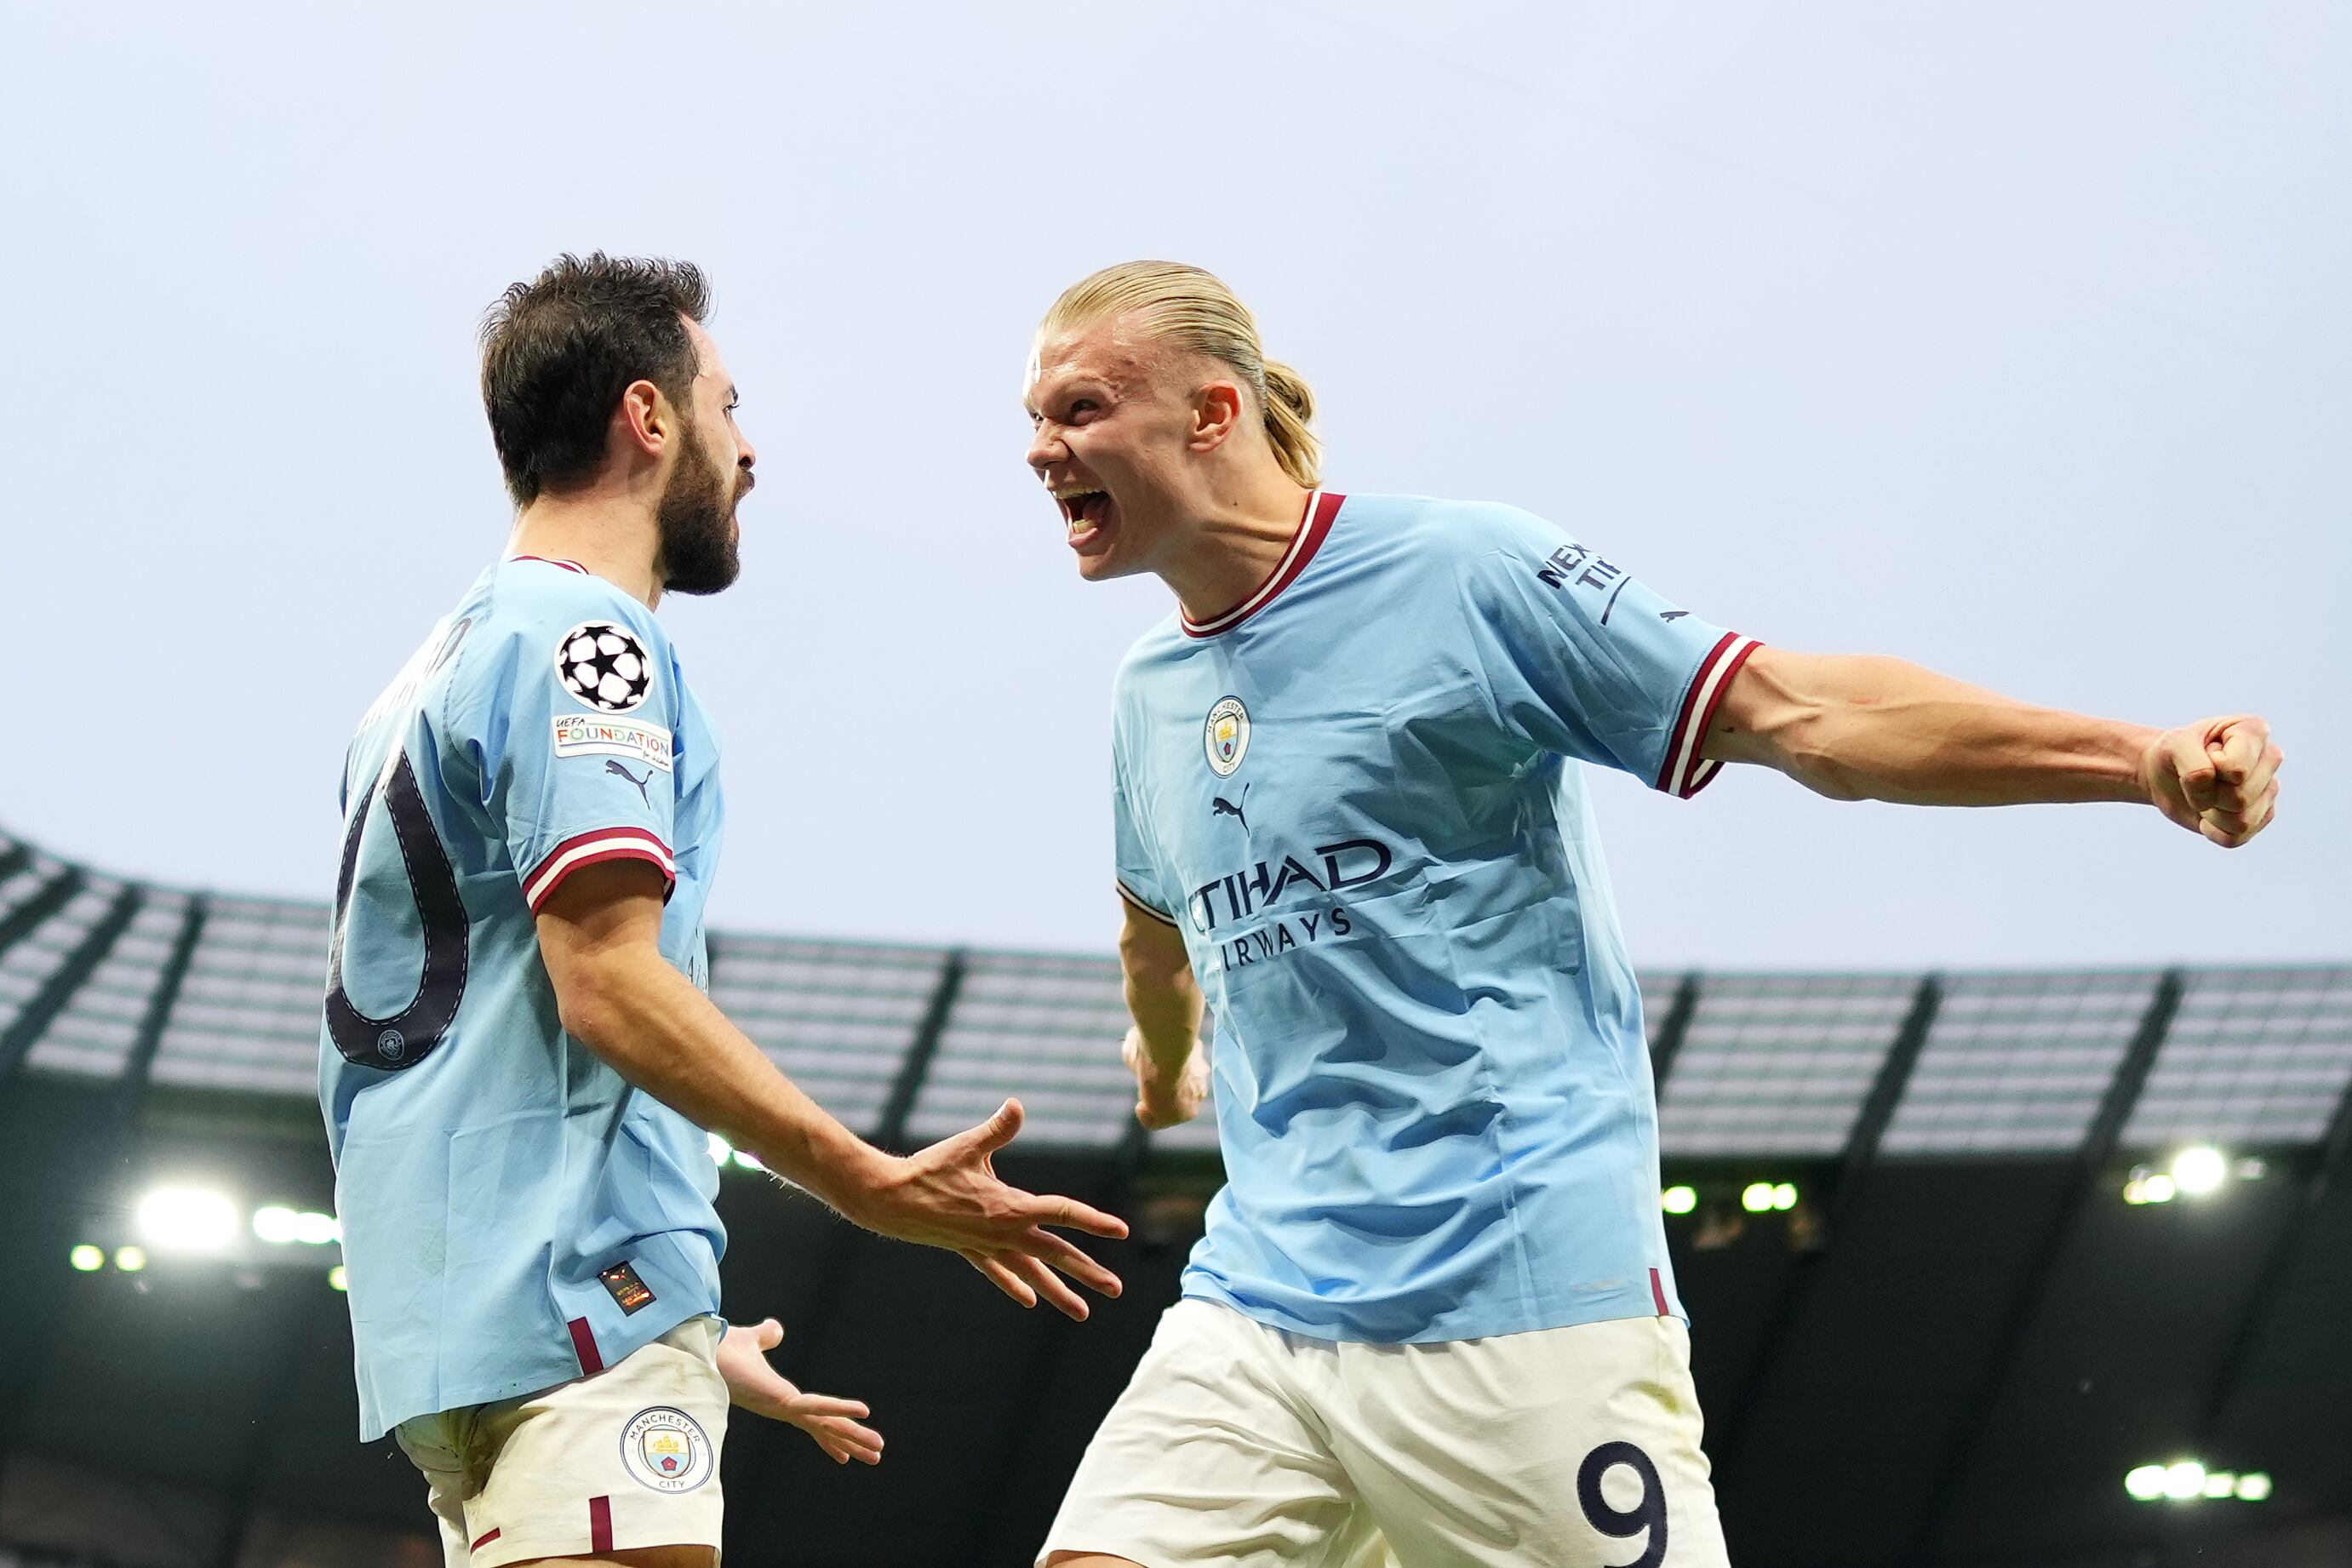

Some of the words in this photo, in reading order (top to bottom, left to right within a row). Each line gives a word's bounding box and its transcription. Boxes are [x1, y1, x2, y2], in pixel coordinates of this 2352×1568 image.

[556, 717, 586, 728] UEFA
[1208, 701, 1245, 735] MANCHESTER
[558, 727, 669, 758] FOUNDATION
[1222, 762, 1236, 774] CITY
[1221, 907, 1352, 972] IRWAYS
[630, 1414, 701, 1444] MANCHESTER
[1577, 1440, 1668, 1568] 9
